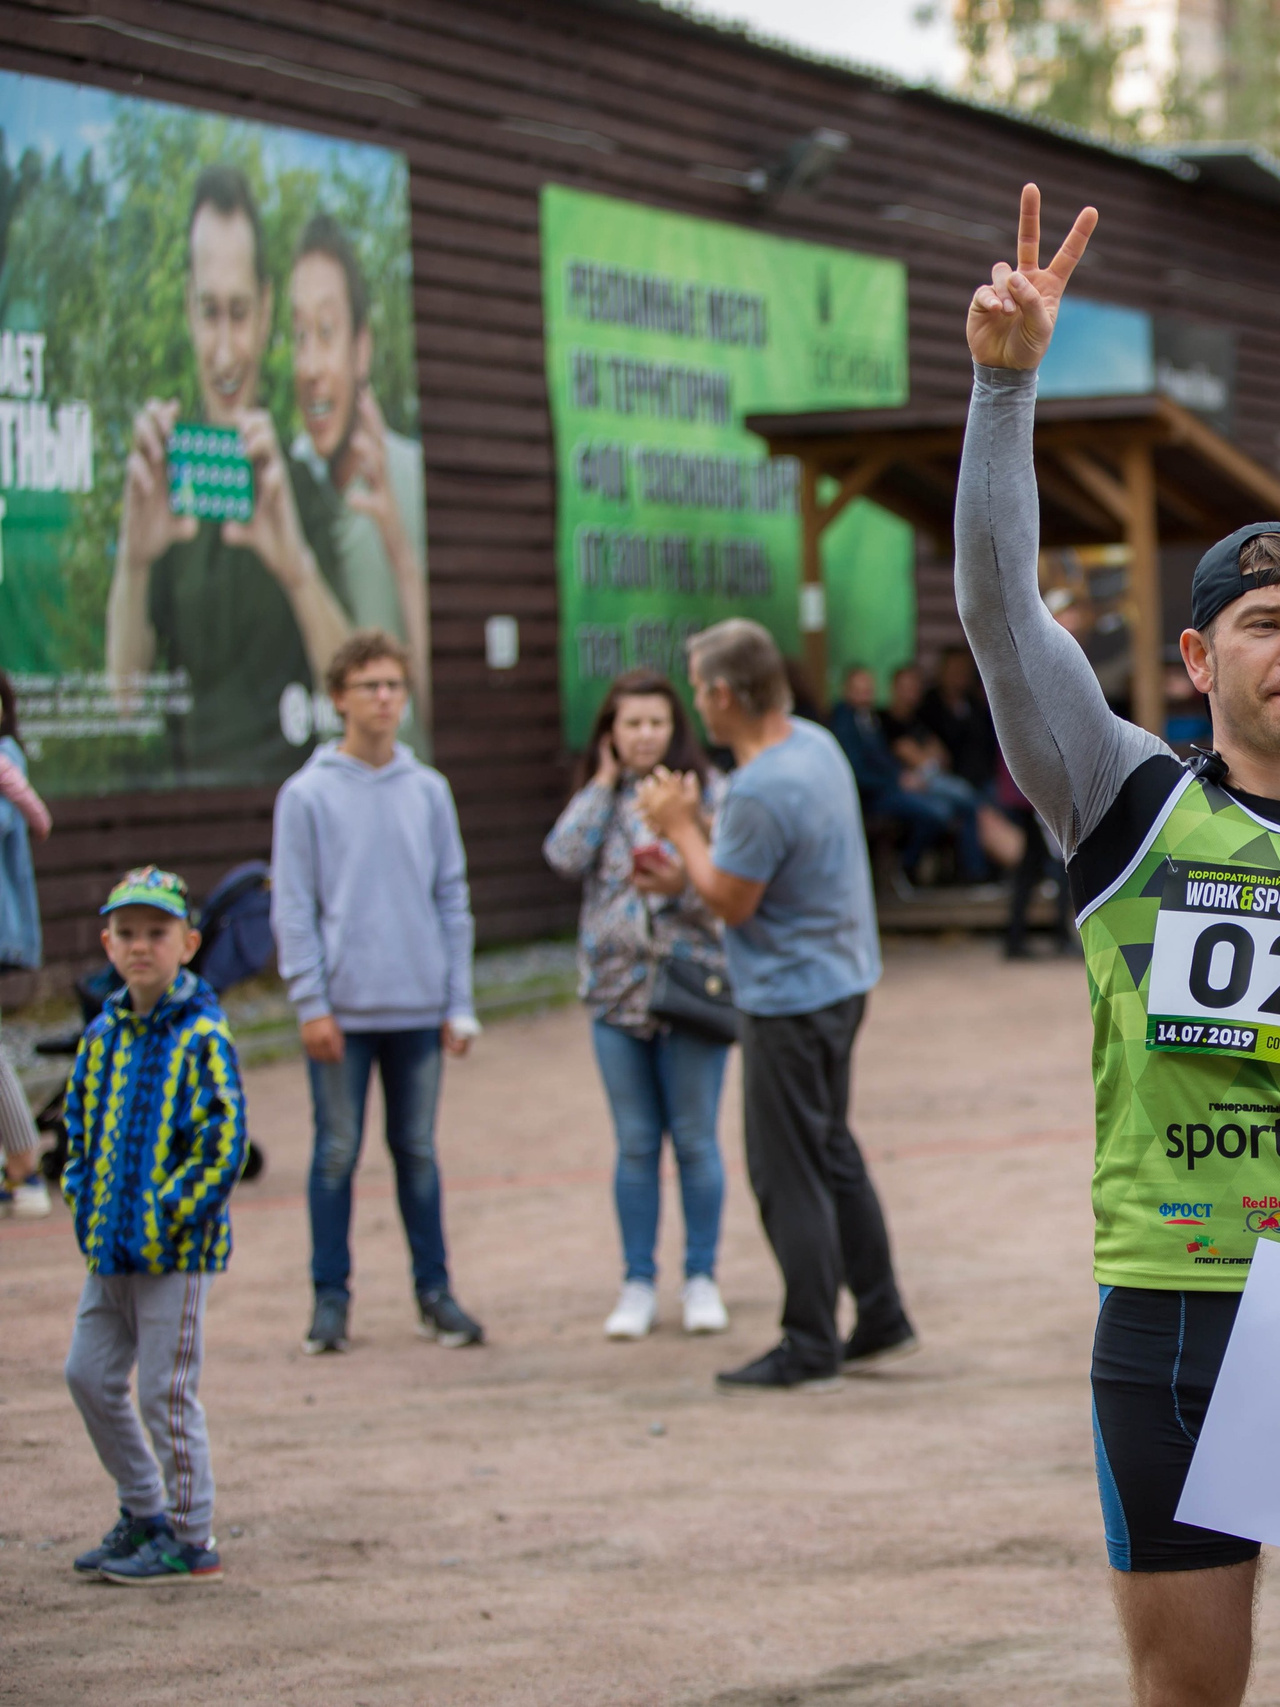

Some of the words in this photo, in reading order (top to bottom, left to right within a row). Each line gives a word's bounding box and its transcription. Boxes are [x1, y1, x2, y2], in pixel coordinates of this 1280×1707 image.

[1157, 1024, 1255, 1048] 14.07.2019
[1243, 1196, 1267, 1208] Red
[1159, 1202, 1213, 1218] ФРОСТ
[1222, 1257, 1254, 1265] cinem
